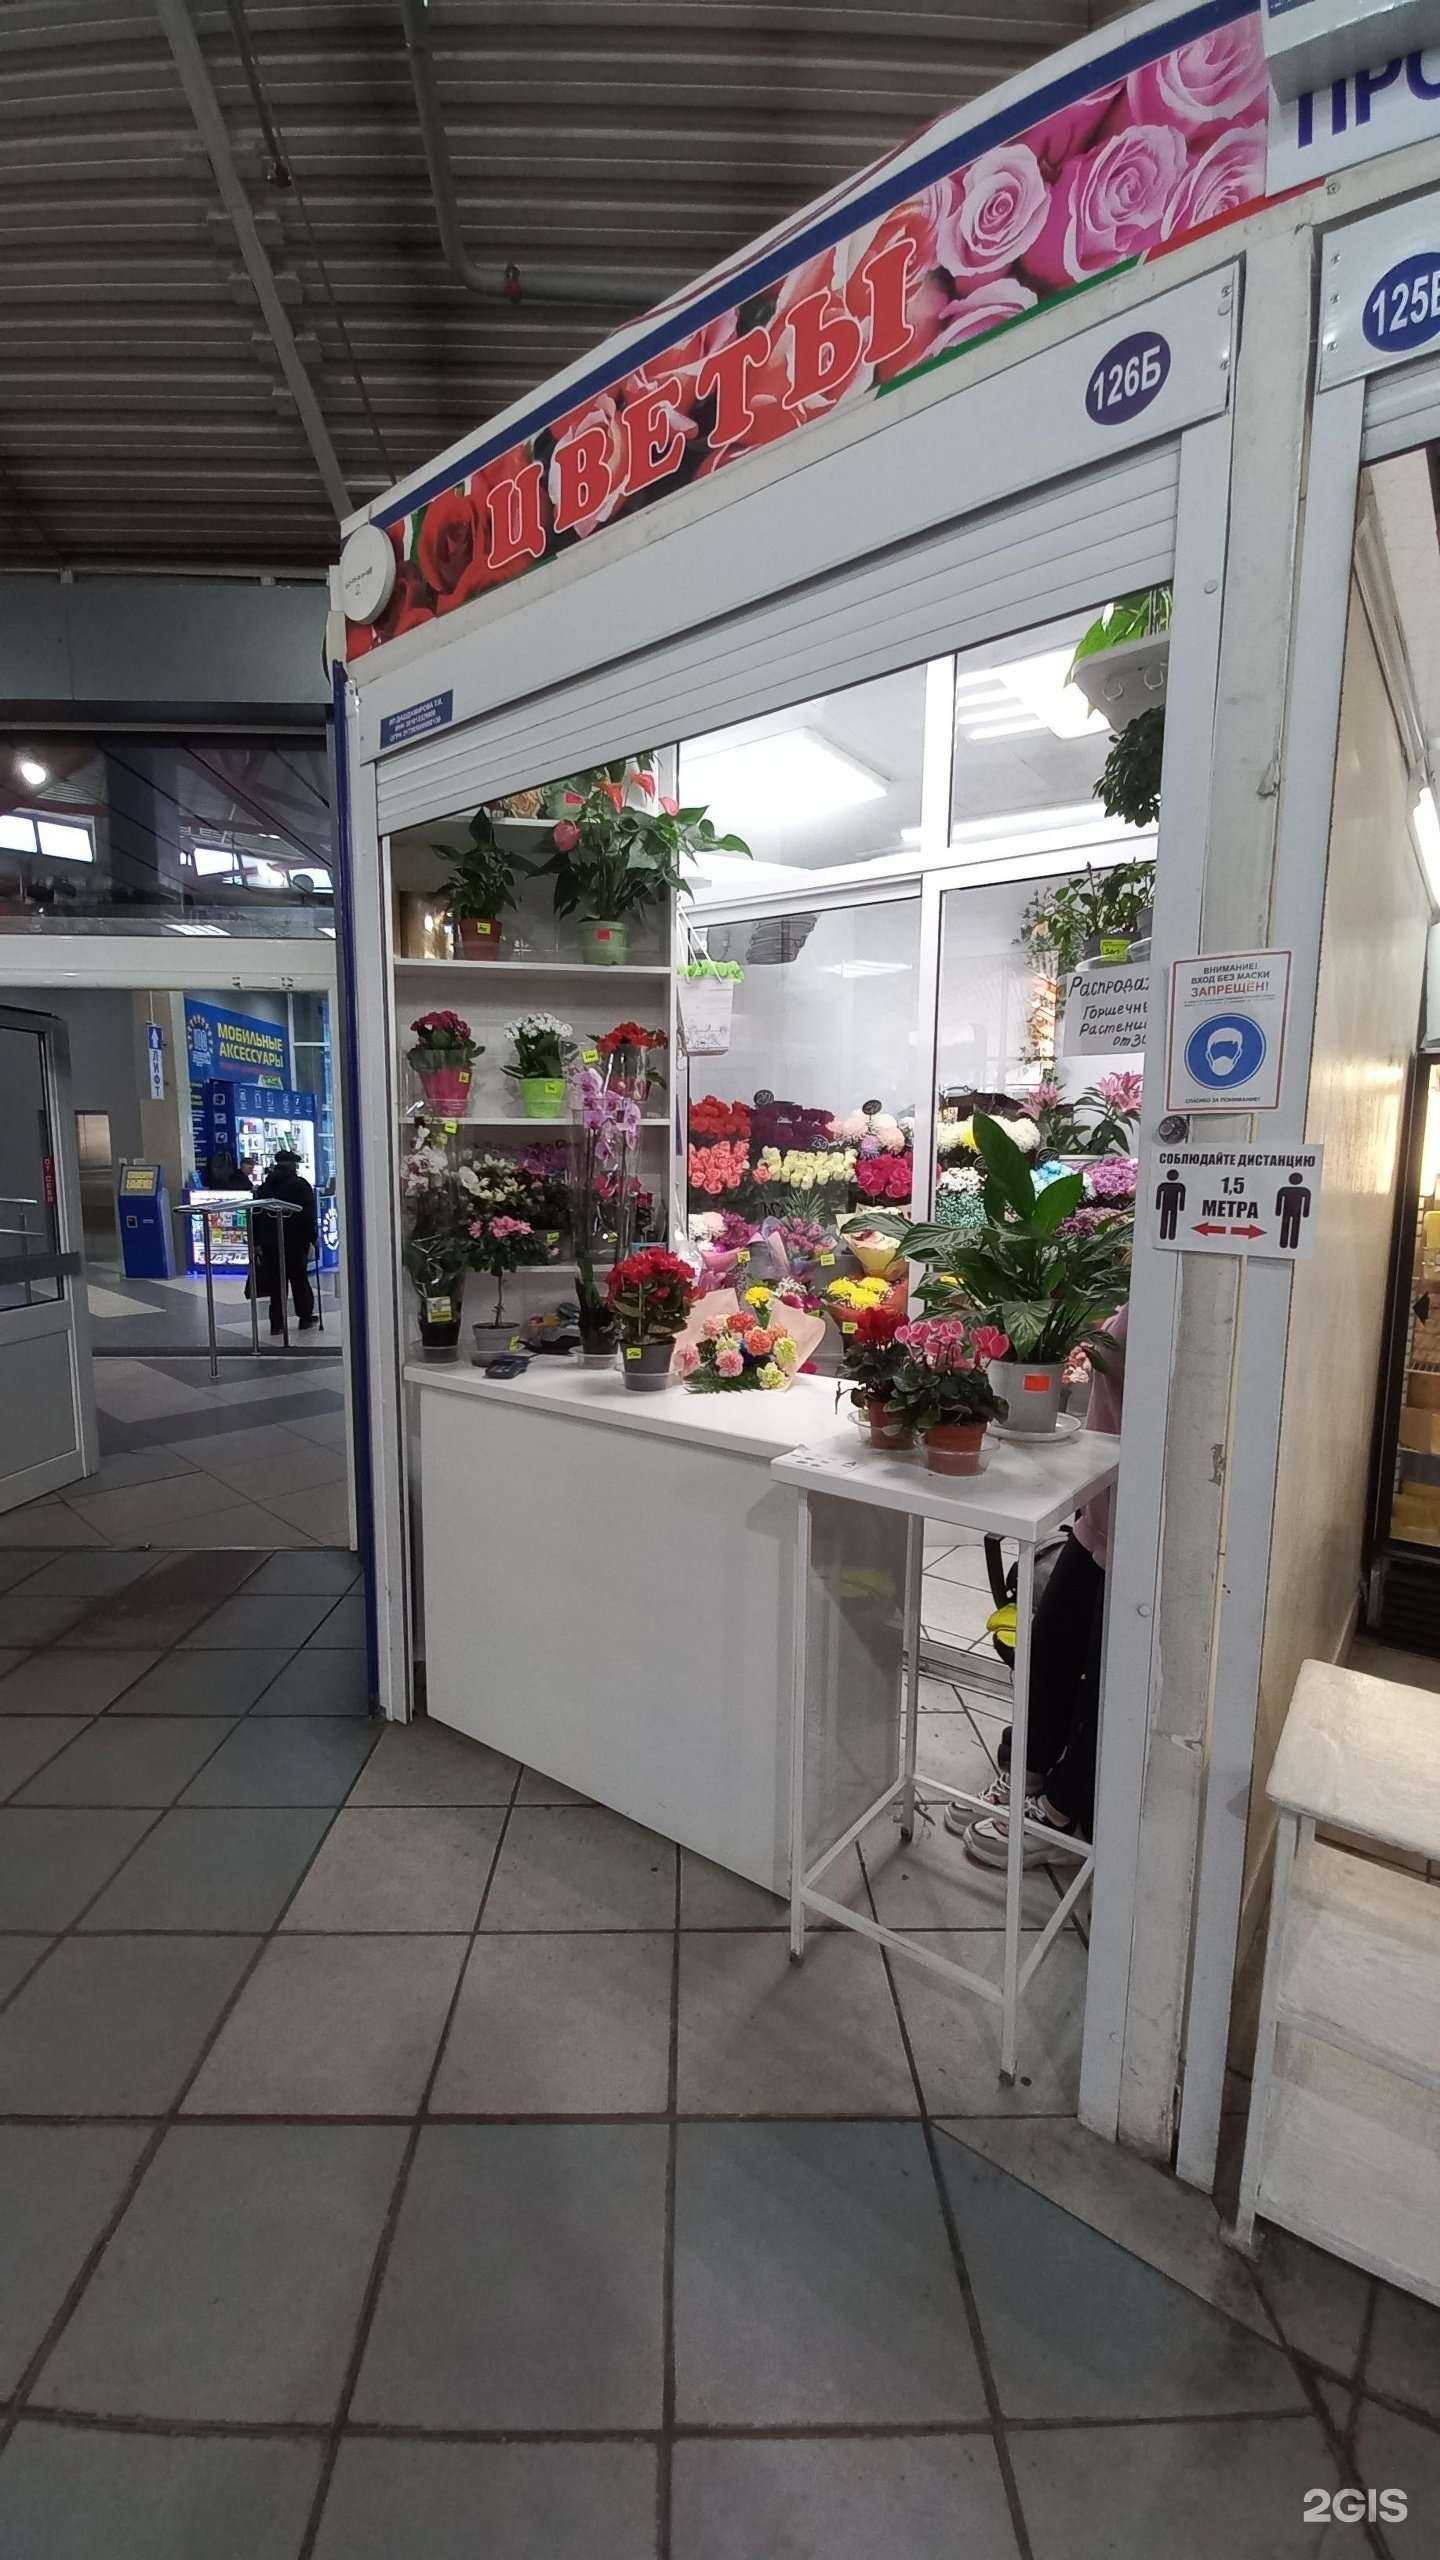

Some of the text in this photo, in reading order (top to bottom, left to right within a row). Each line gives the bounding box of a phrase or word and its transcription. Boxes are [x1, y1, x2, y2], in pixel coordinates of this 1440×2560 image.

[1093, 345, 1162, 410] 126Б
[487, 237, 917, 570] ЦВЕТЫ
[1191, 970, 1271, 985] ВХОД БЕЗ МАСКИ
[1203, 962, 1258, 975] ВНИМАНИЕ!
[1068, 976, 1150, 998] Распрода
[1191, 981, 1269, 998] ЗАПРЕЩЕН!
[217, 1022, 283, 1052] МОБИЛЬНЫЕ
[1079, 1021, 1147, 1037] Растени
[219, 1041, 284, 1068] АКСЕССУАРЫ
[1159, 1152, 1316, 1168] СОБЛЮДАЙТЕ ДИСТАНЦИЮ
[1221, 1176, 1245, 1196] 1,5
[1202, 1199, 1259, 1219] МЕТРА
